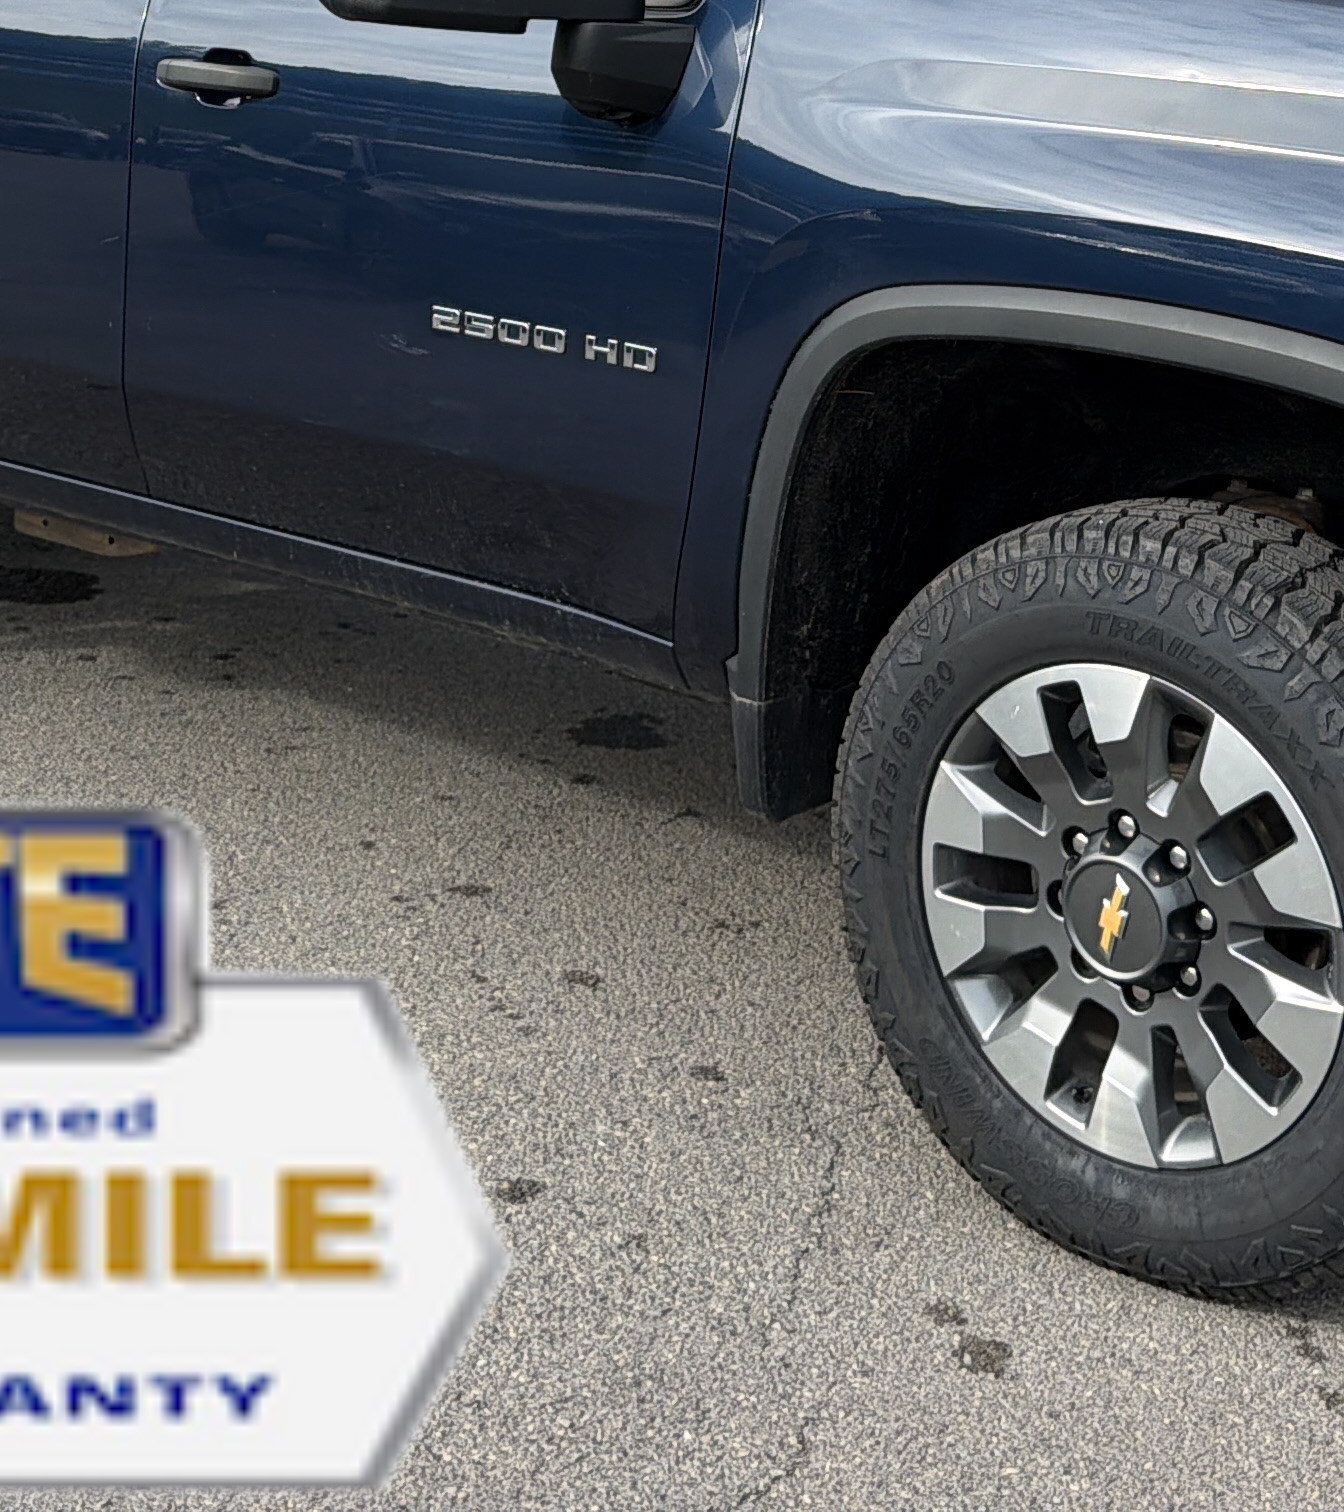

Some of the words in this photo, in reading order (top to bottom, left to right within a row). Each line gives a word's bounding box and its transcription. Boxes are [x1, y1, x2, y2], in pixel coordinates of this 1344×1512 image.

[430, 304, 567, 355] 2500
[583, 333, 658, 374] HD
[867, 659, 956, 862] LT275/65R20
